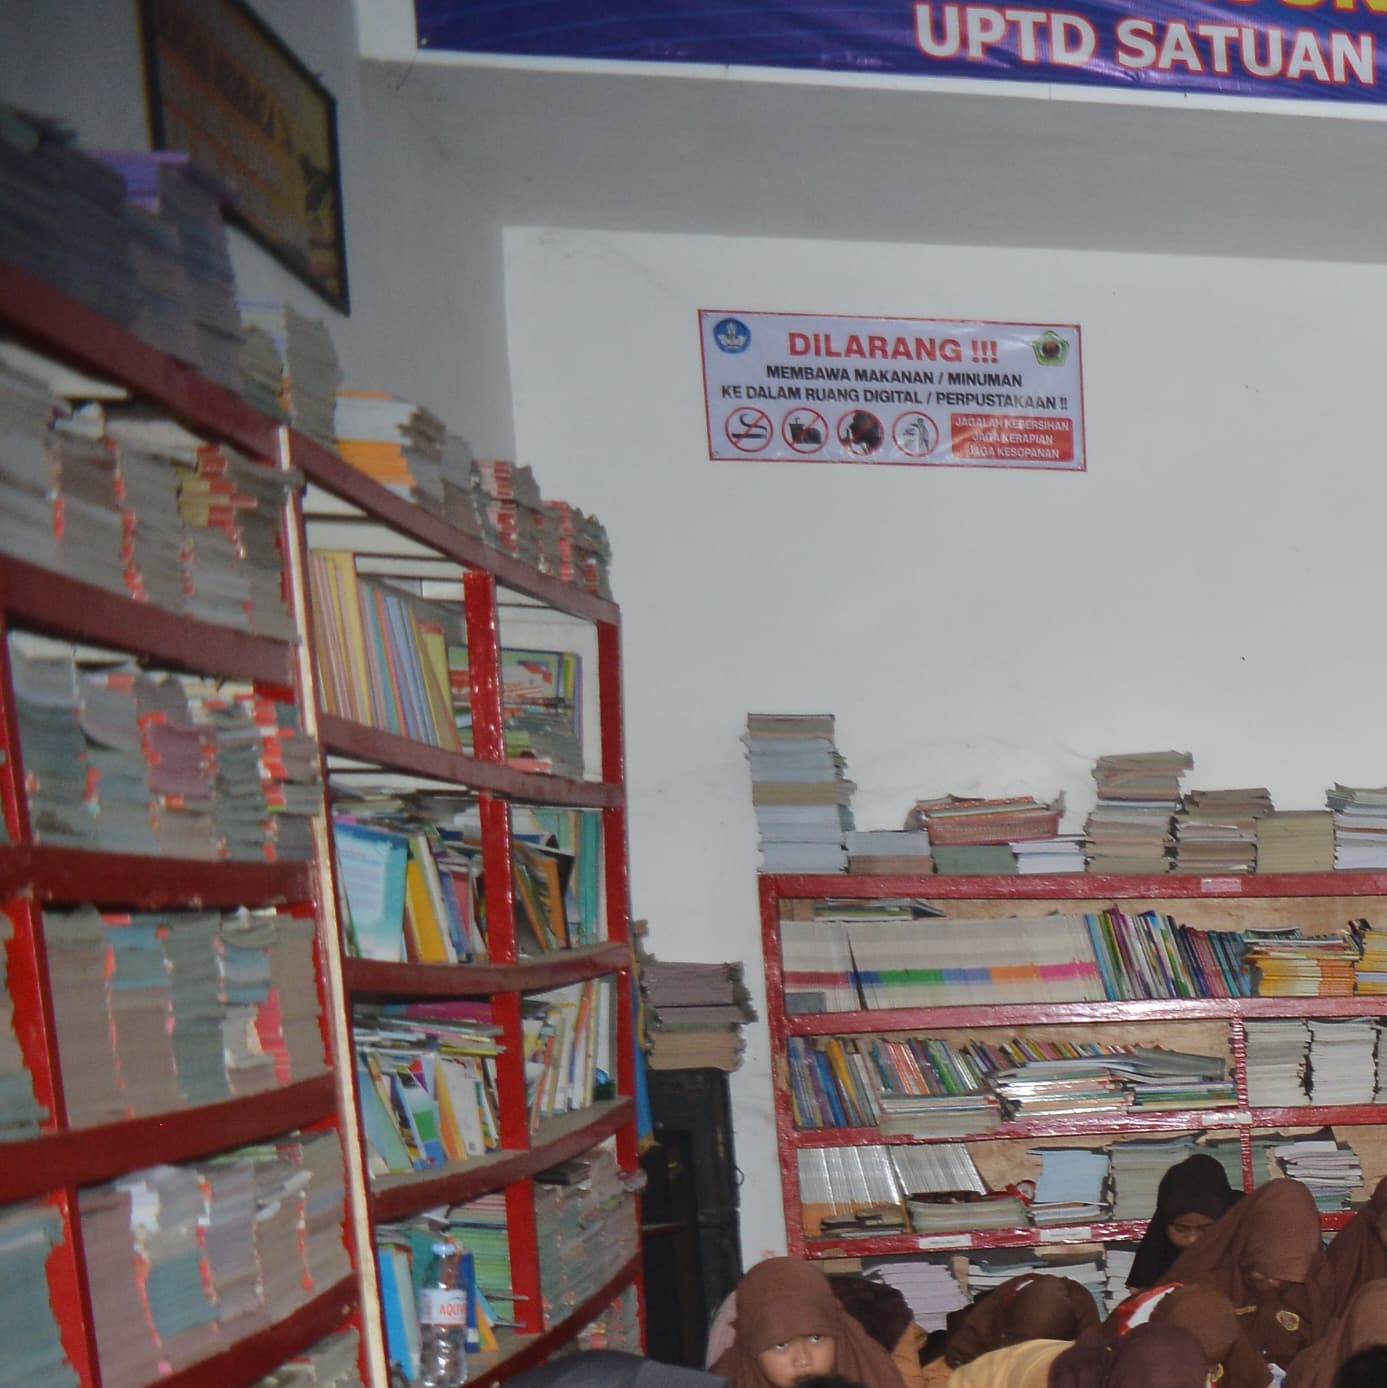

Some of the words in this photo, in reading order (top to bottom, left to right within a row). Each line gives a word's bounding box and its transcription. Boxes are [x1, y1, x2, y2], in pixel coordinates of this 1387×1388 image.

[914, 3, 1098, 66] UPTD
[1115, 20, 1376, 86] SATUAN
[788, 332, 963, 363] DILARANG
[971, 340, 998, 363] !!!
[766, 365, 851, 381] MEMBAWA
[854, 368, 934, 385] MAKANAN
[949, 372, 1023, 387] MINUMAN
[721, 385, 742, 399] KE
[746, 385, 801, 401] DALAM
[805, 387, 859, 402] RUANG
[863, 389, 922, 405] DIGITAL
[936, 392, 1056, 410] PERPUSTAKAAN
